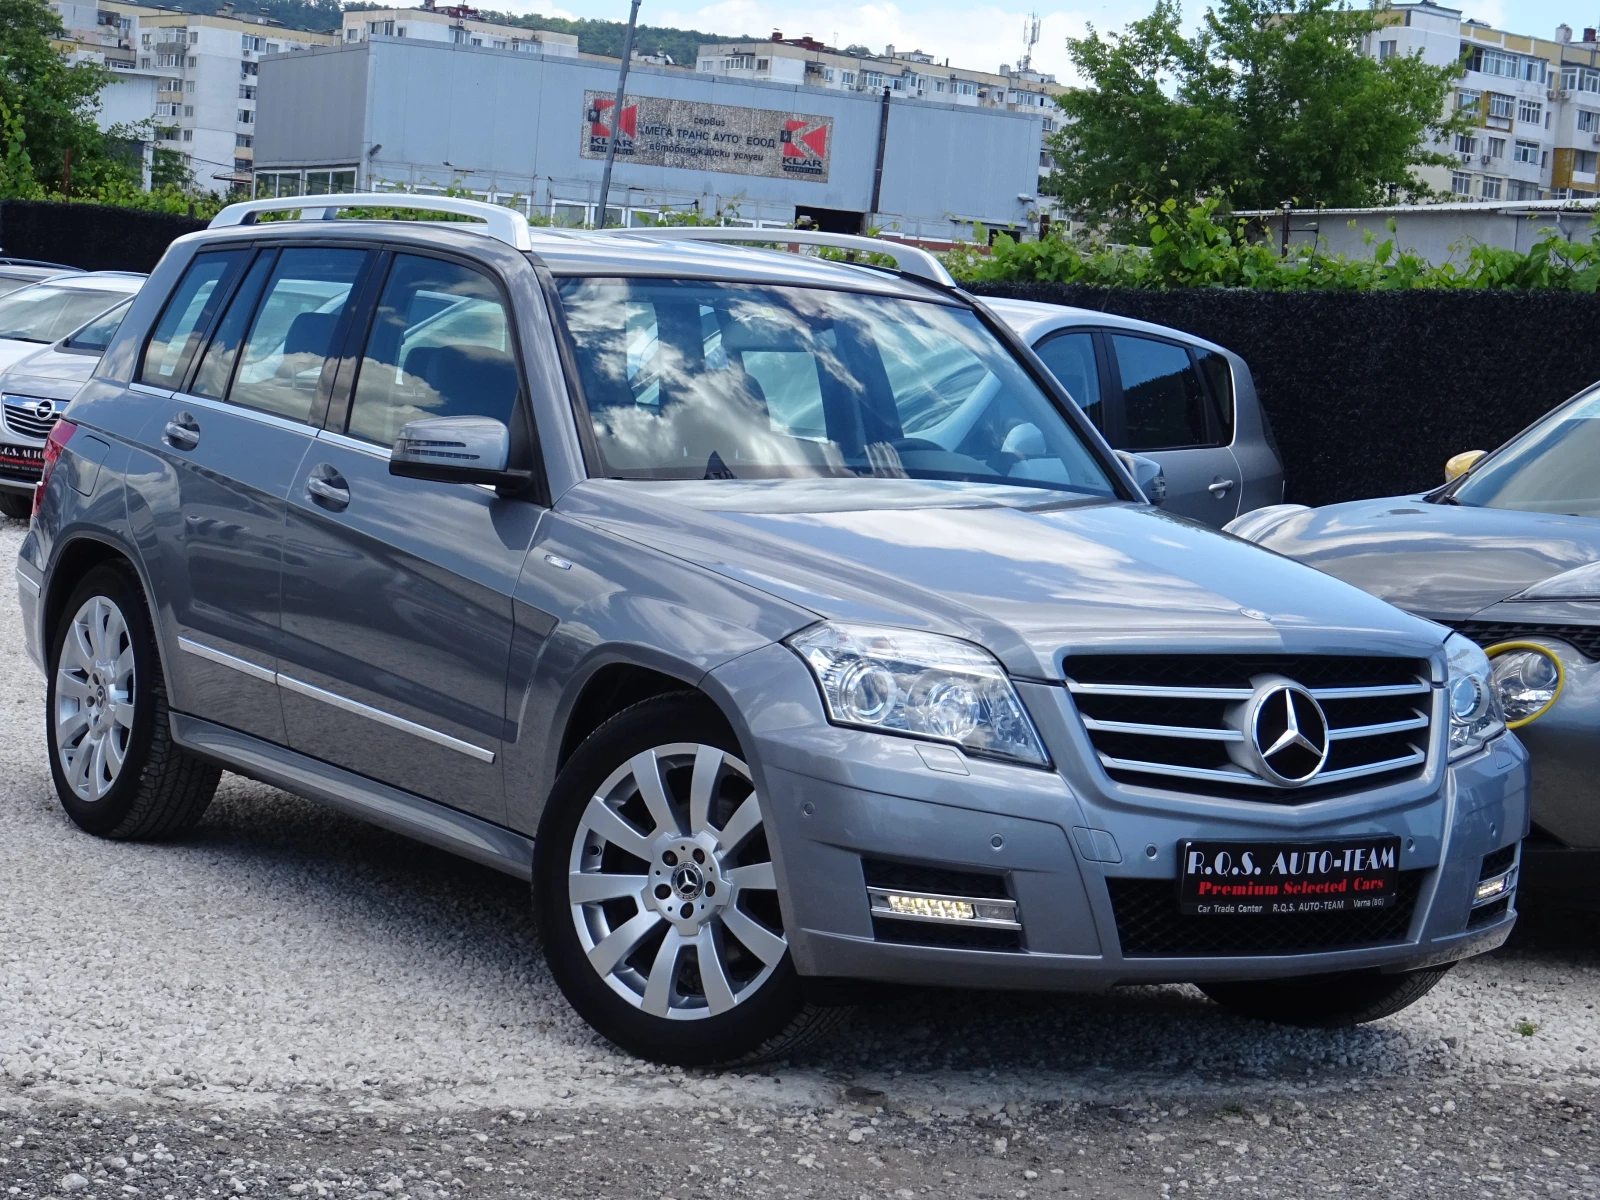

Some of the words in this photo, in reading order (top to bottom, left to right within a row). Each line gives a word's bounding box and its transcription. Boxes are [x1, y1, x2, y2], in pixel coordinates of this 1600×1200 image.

[694, 117, 726, 127] сервиз
[677, 129, 709, 141] ТРАНС
[746, 137, 776, 149] ЕООД
[733, 151, 764, 162] услуги
[782, 157, 822, 168] KLAR
[1187, 851, 1262, 877] R.Q.S.
[1269, 846, 1395, 875] AUTO-TEAM
[1198, 881, 1279, 895] Premium
[1283, 879, 1347, 895] Selected
[1353, 877, 1384, 891] Cars
[1197, 904, 1211, 913] Car
[1214, 904, 1235, 913] Trade
[1238, 904, 1263, 913] Center
[1273, 903, 1296, 913] R.Q.S.
